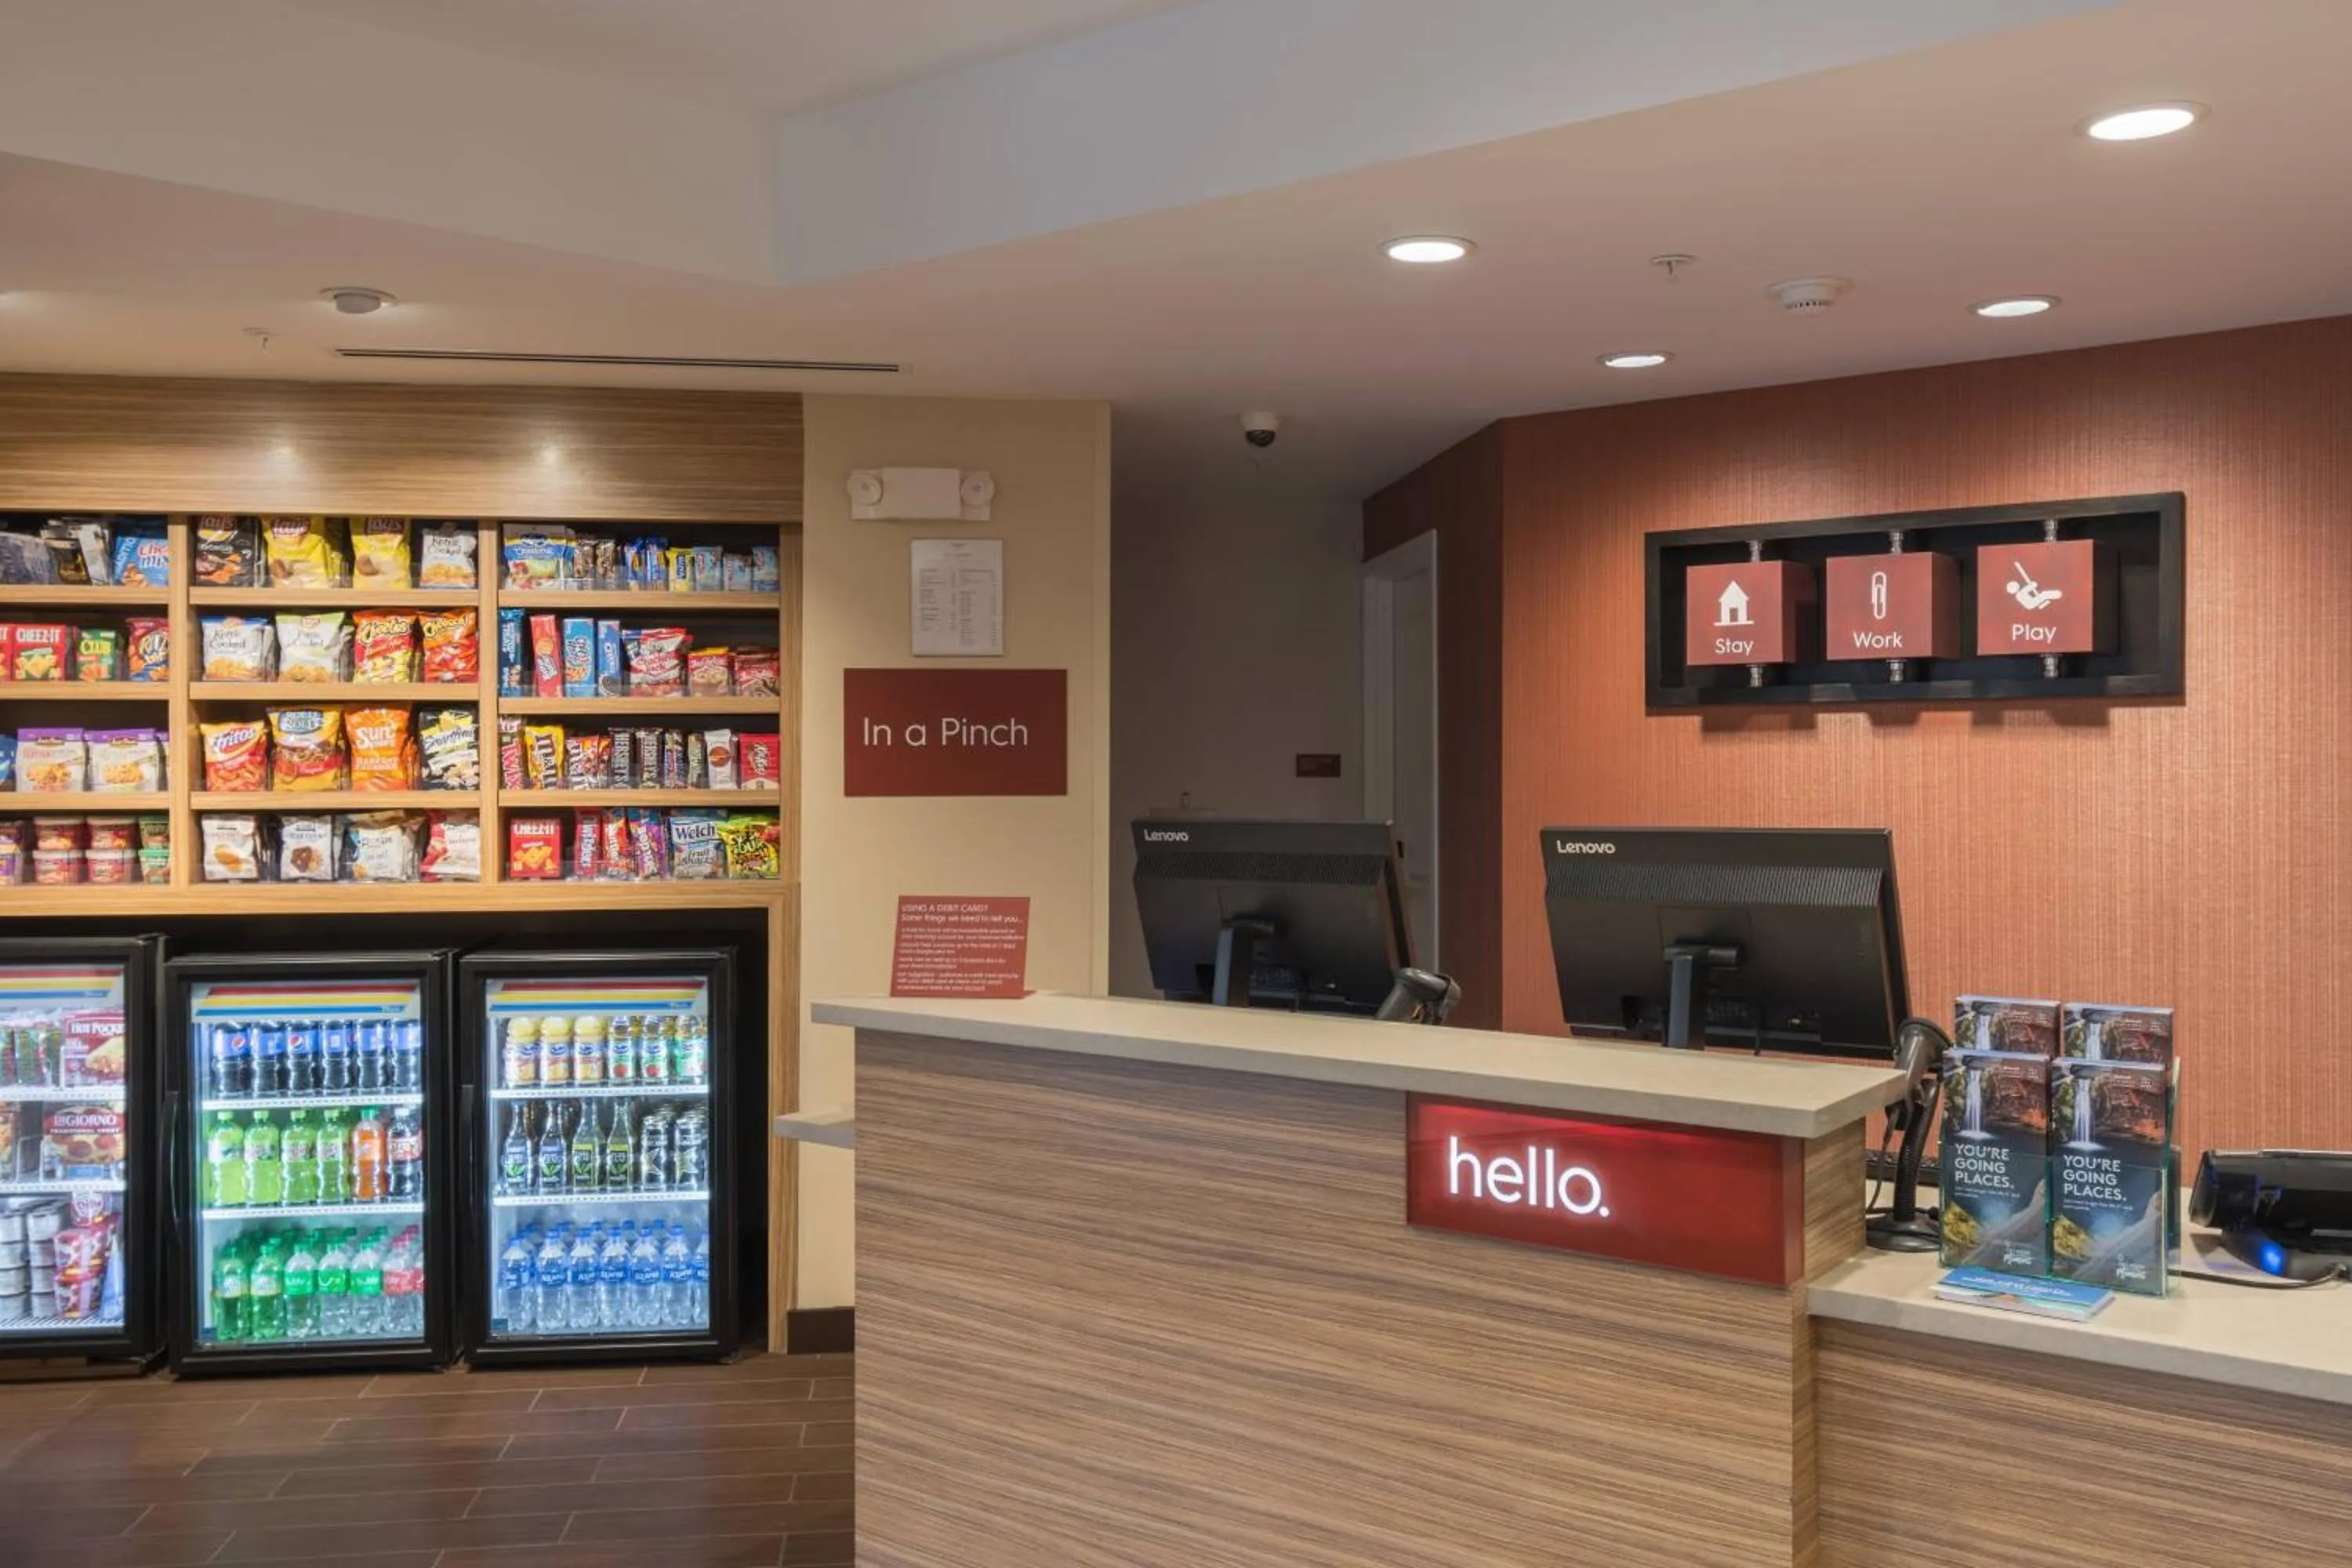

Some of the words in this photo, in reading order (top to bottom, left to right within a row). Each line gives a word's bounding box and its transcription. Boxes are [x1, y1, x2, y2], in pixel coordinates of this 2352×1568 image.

[1853, 631, 1904, 649] Work
[2011, 623, 2057, 644] Play
[81, 639, 111, 655] CLUB
[1715, 637, 1754, 656] Stay
[864, 717, 891, 746] In
[906, 724, 927, 746] a
[942, 717, 1028, 746] Pinch
[675, 826, 716, 840] Welch
[1144, 829, 1189, 841] Lenovo
[1556, 840, 1617, 854] Lenovo
[92, 1022, 125, 1036] POCKE
[1955, 1143, 2010, 1161] YOU'RE
[1955, 1158, 2005, 1174] GOING
[2063, 1154, 2121, 1173] YOU'RE
[1448, 1135, 1610, 1218] hello.
[1955, 1171, 2015, 1189] PLACES.
[2063, 1168, 2118, 1185] GOING
[2063, 1183, 2127, 1201] PLACES.
